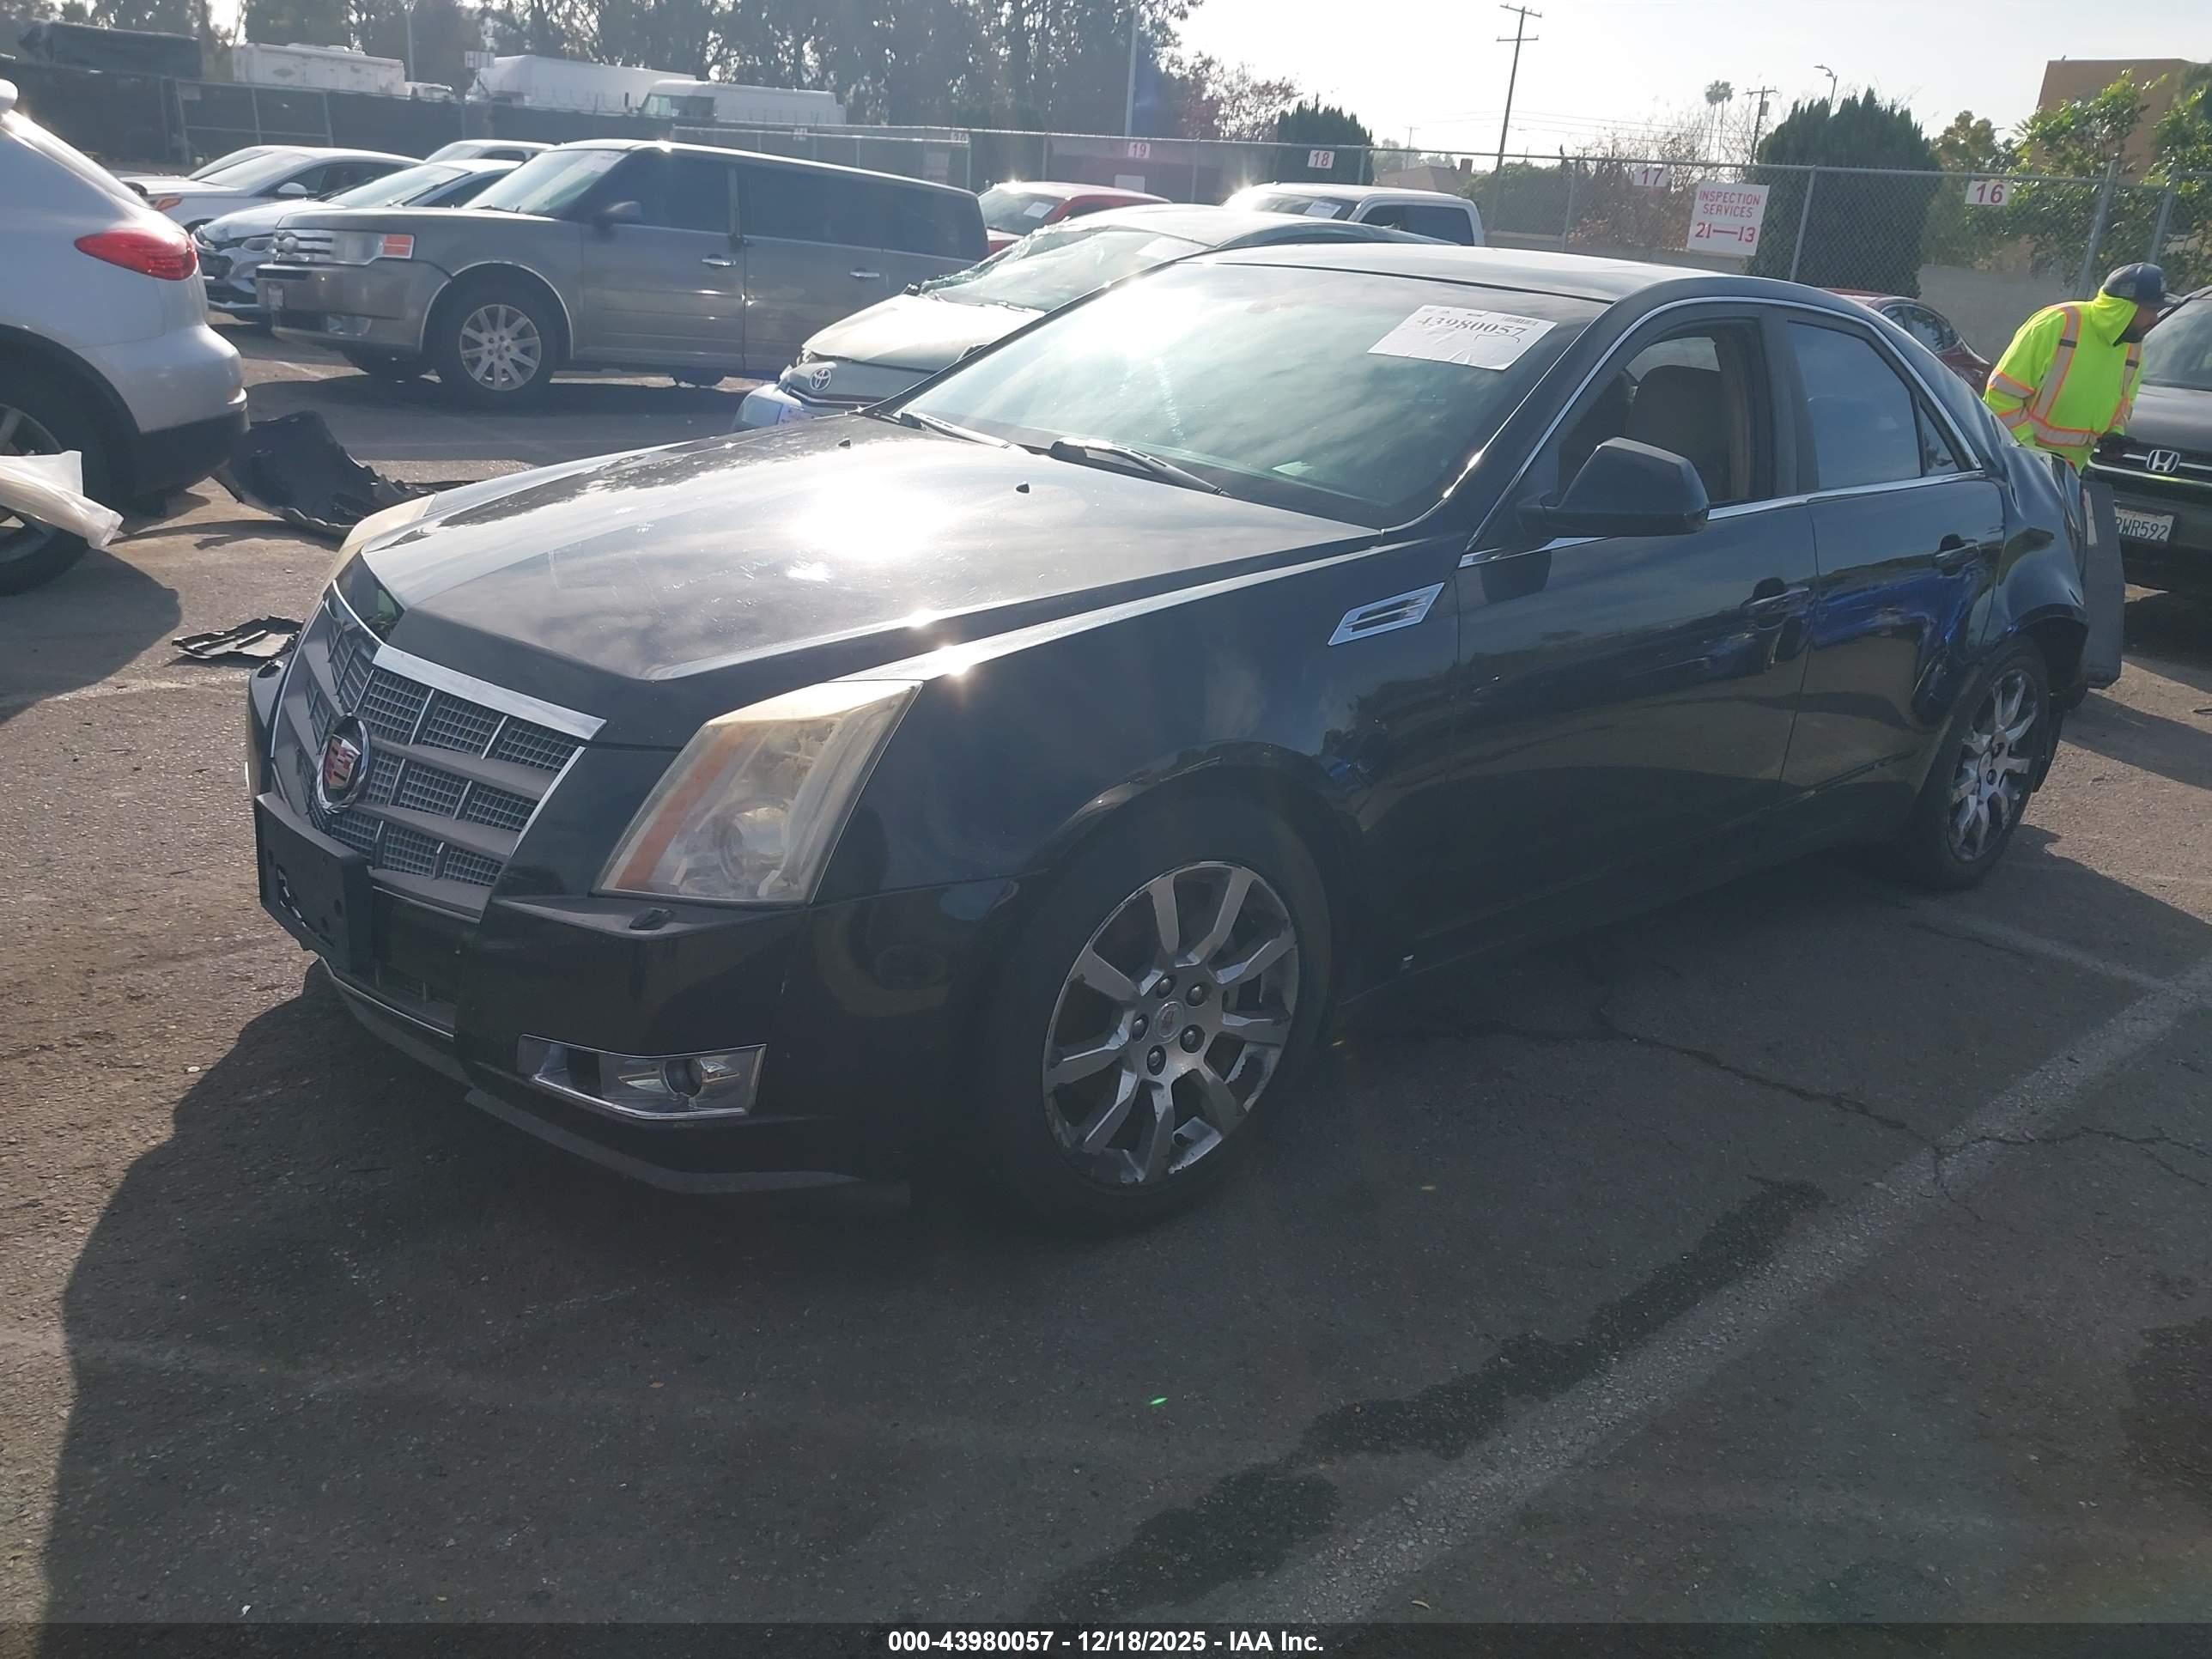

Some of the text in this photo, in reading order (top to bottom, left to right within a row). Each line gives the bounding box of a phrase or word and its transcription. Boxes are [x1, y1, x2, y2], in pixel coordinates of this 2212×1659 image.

[1133, 143, 1146, 158] 19
[1314, 151, 1330, 167] 18
[1641, 167, 1664, 185] 17
[1698, 191, 1760, 205] INSPECTION
[1977, 183, 2004, 204] 16
[1703, 204, 1753, 218] SERVICES
[1417, 316, 1528, 336] 43980057
